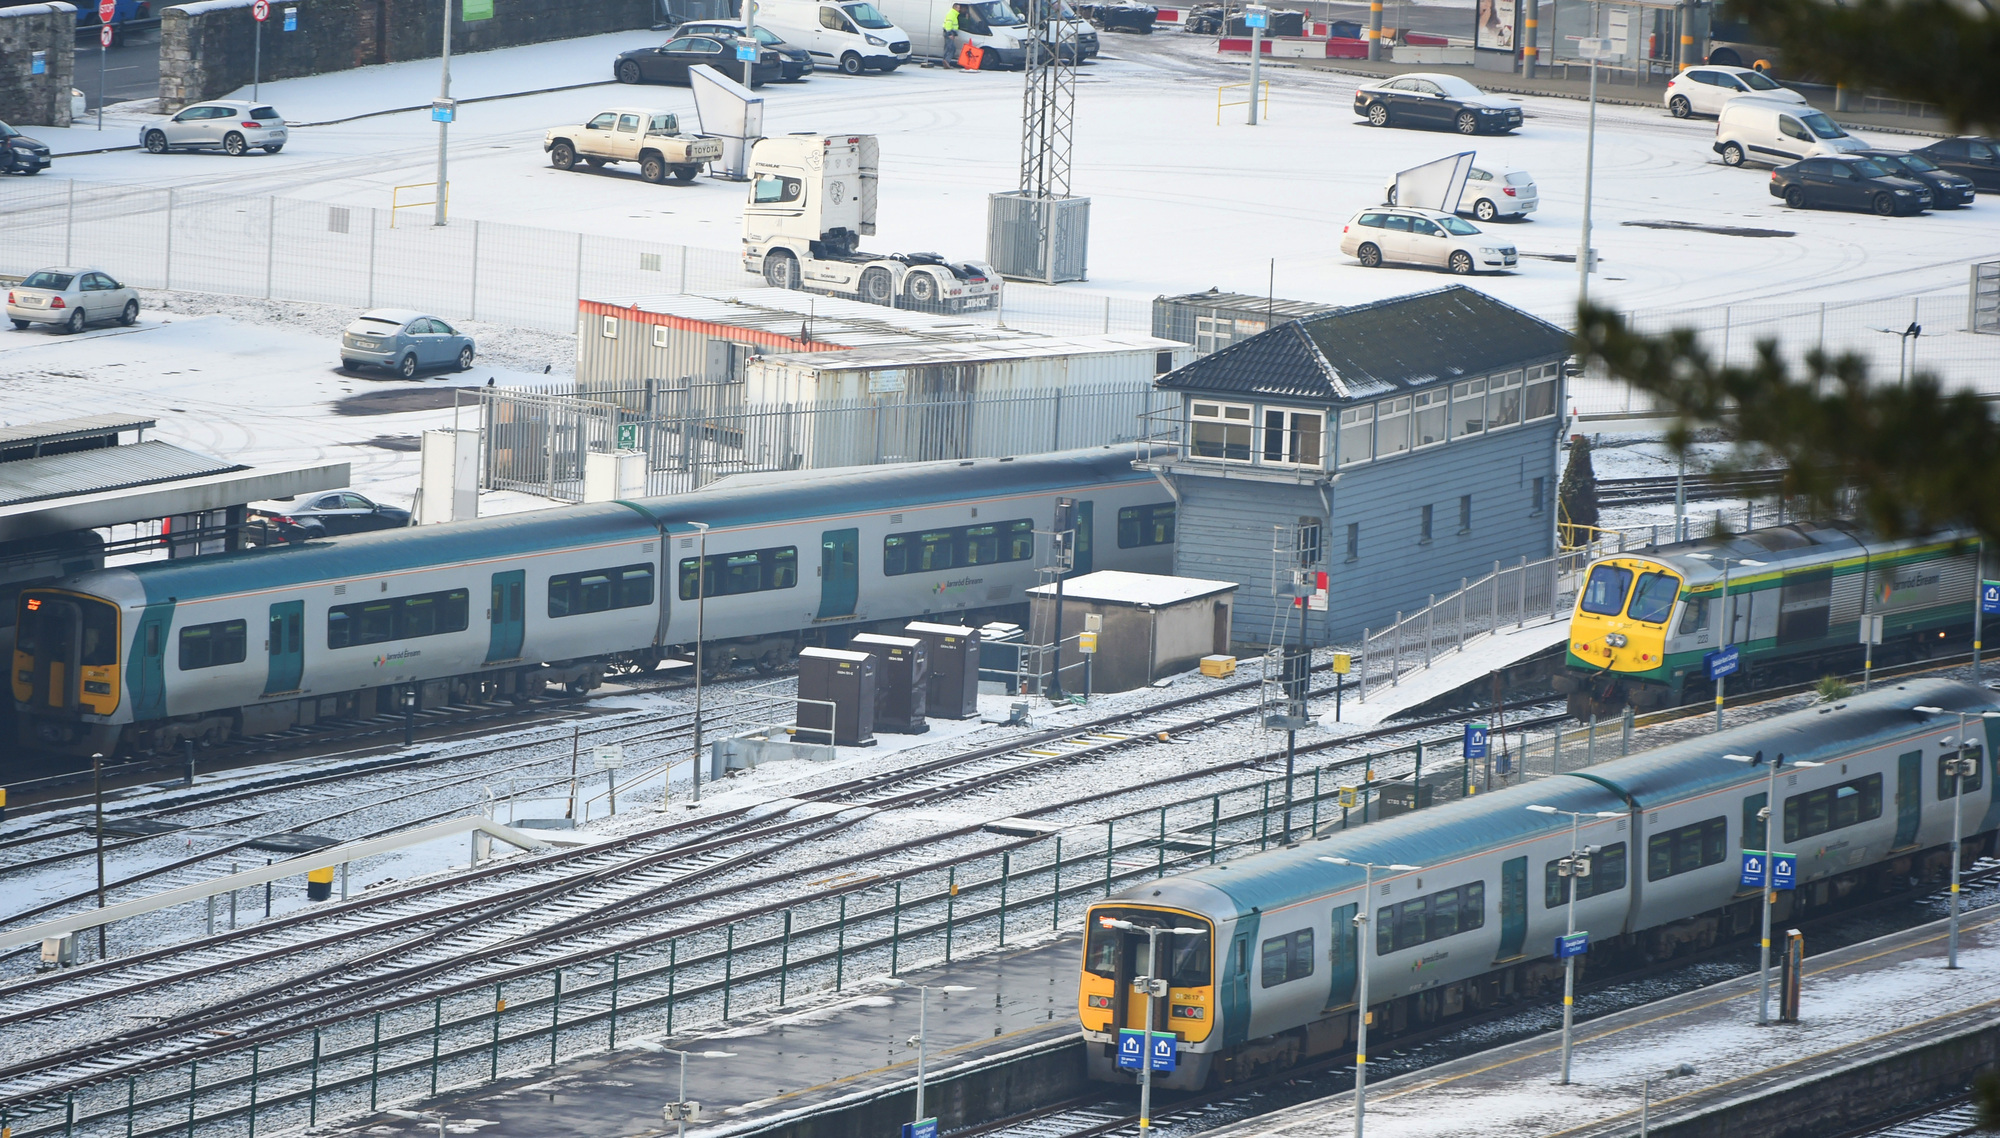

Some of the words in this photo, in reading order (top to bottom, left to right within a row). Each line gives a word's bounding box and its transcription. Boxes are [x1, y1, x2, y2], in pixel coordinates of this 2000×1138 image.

[100, 3, 114, 14] STOP
[694, 145, 719, 154] TOYOTA
[1698, 634, 1708, 645] 223
